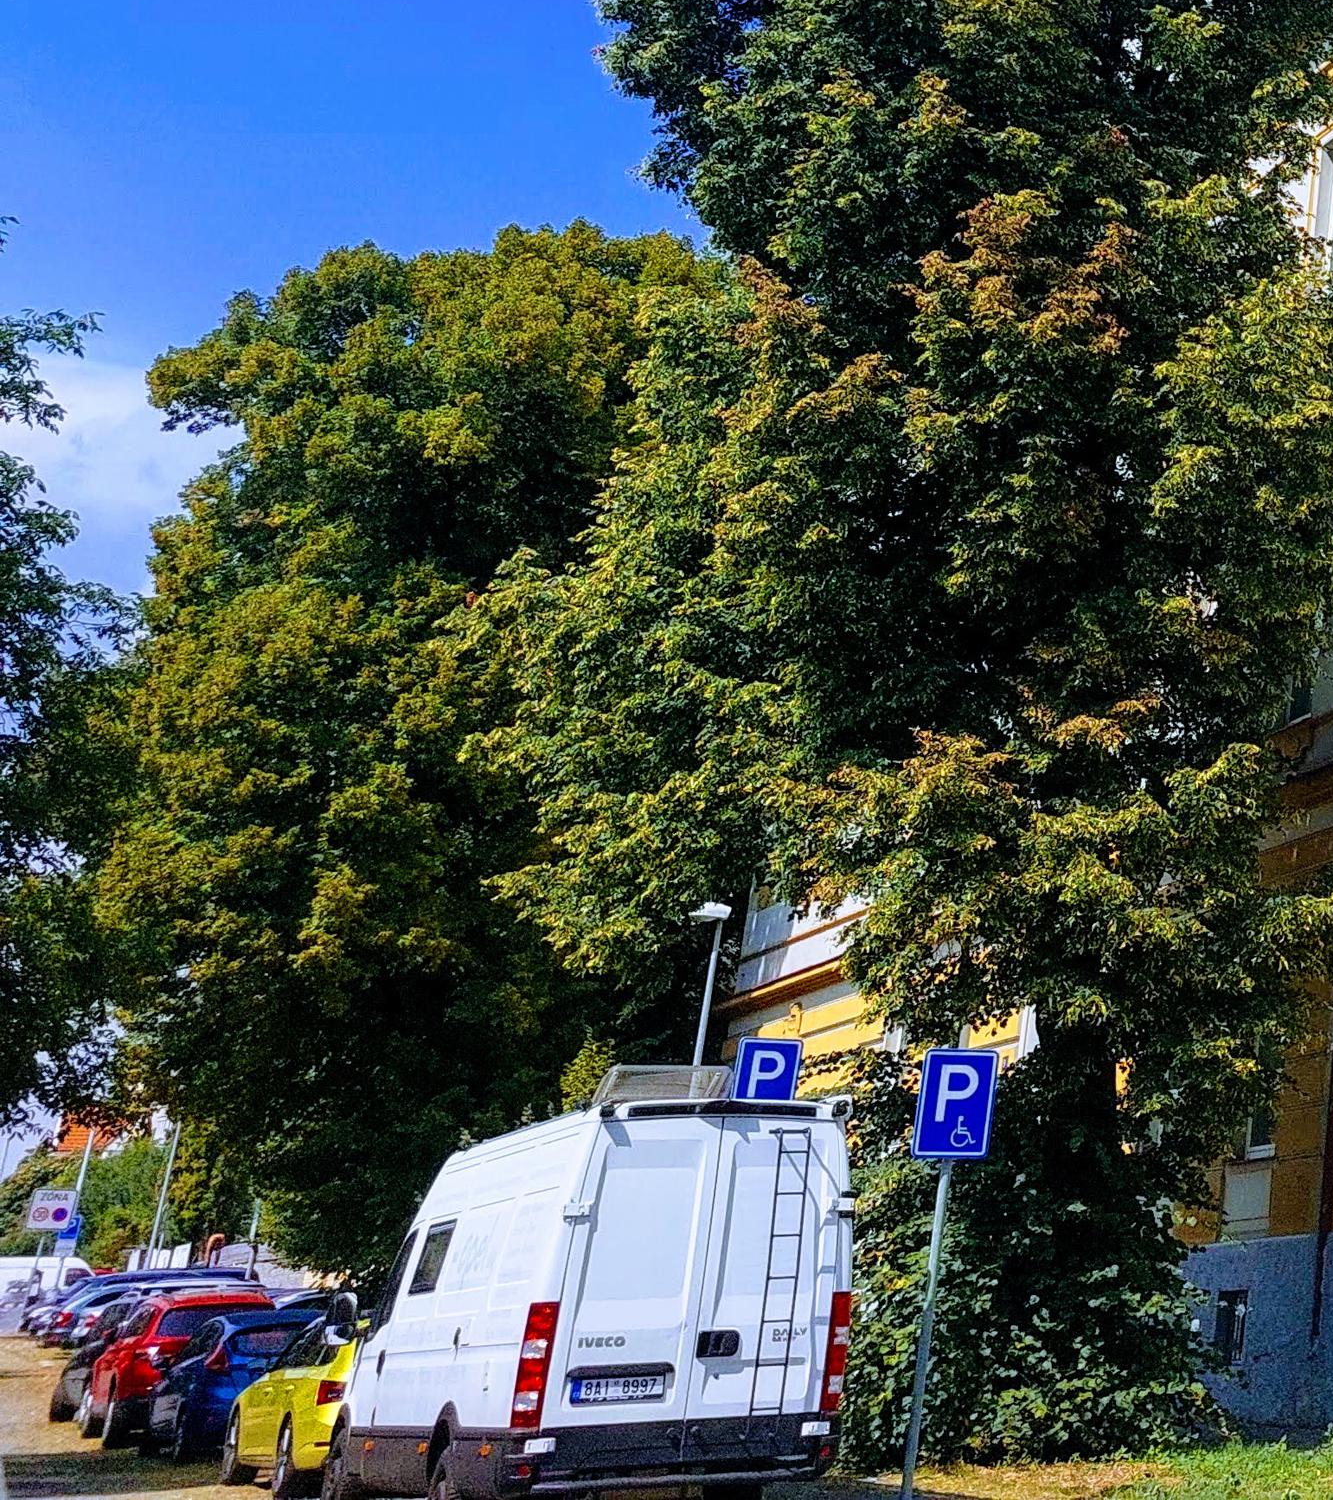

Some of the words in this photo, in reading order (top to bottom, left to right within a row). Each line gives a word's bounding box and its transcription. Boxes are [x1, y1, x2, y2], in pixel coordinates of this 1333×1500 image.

[747, 1050, 786, 1098] P
[935, 1063, 979, 1122] P
[772, 1327, 808, 1336] DALY
[577, 1335, 626, 1348] IVECO
[621, 1377, 658, 1395] 8997
